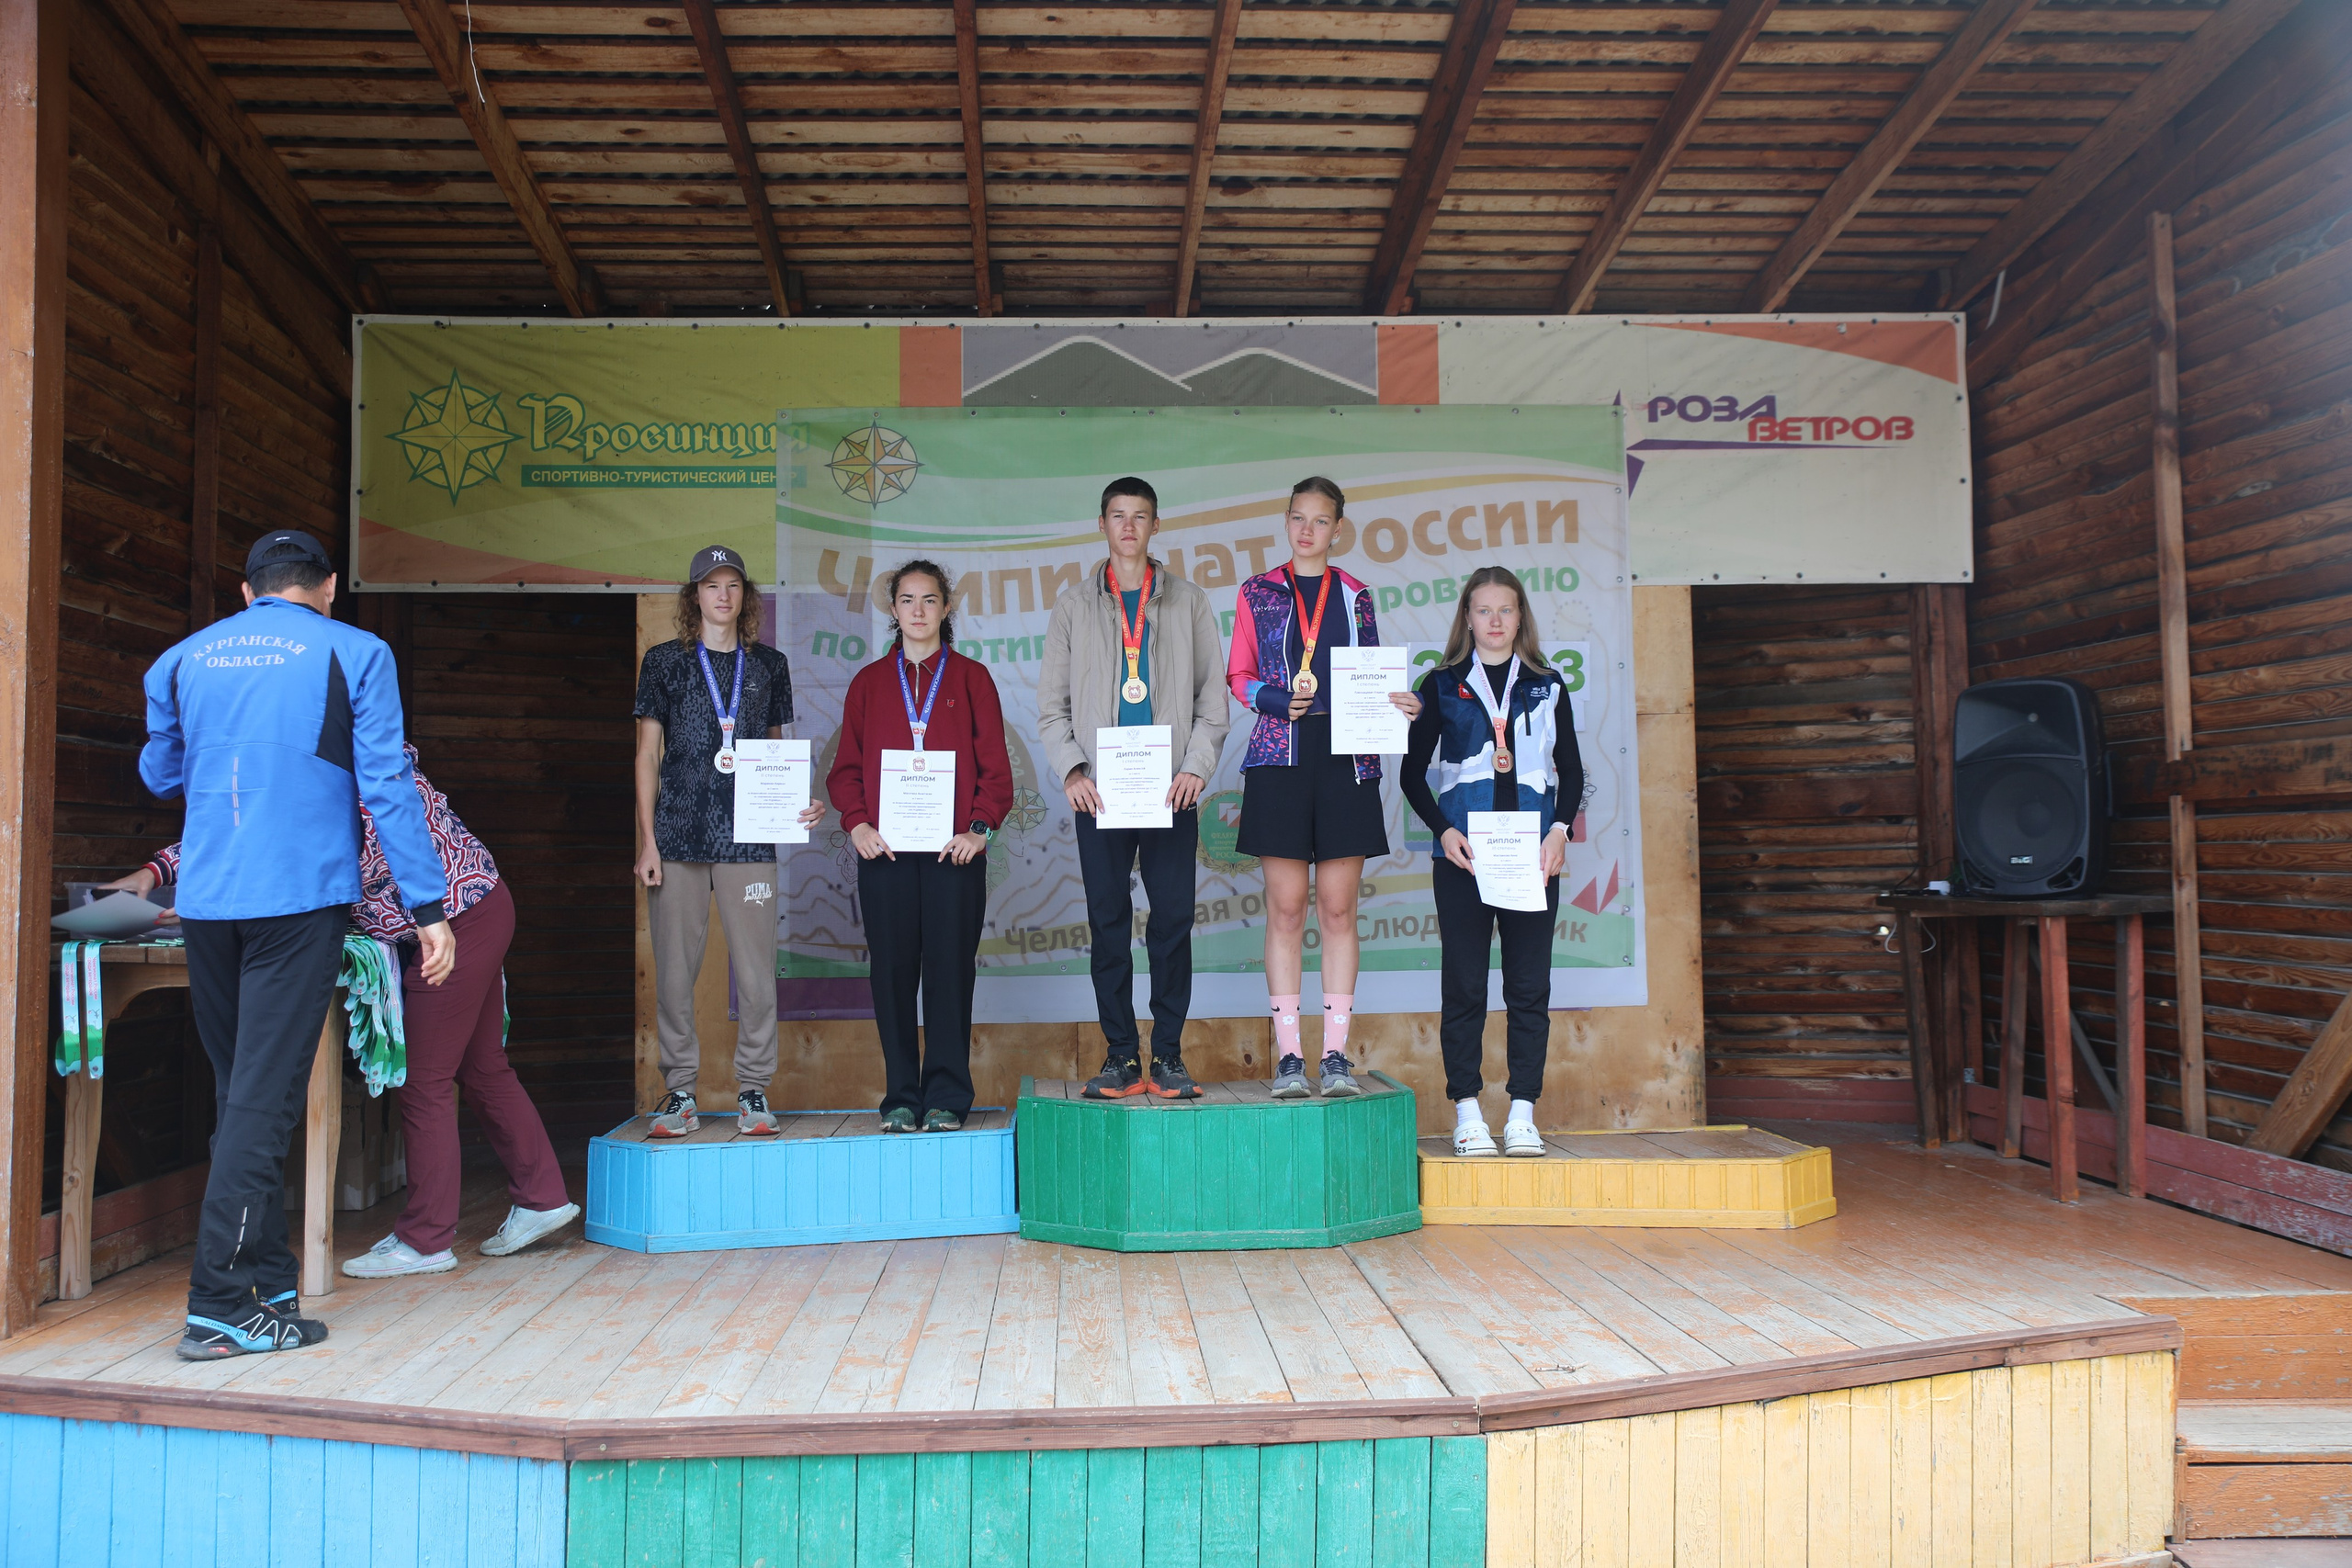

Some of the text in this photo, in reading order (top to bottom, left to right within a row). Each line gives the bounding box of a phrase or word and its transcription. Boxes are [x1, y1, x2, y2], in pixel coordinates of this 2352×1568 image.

[1647, 395, 1777, 423] РОЗА
[1747, 416, 1915, 443] ВЕТРОВ
[531, 468, 746, 484] СПОРТИВНО-ТУРИСТИЧЕСКИЙ
[193, 635, 308, 661] КУРГАНСКАЯ
[811, 631, 865, 661] по
[206, 653, 286, 669] ОБЛАСТЬ
[745, 883, 771, 896] PUMA
[198, 1319, 232, 1332] SALOMON
